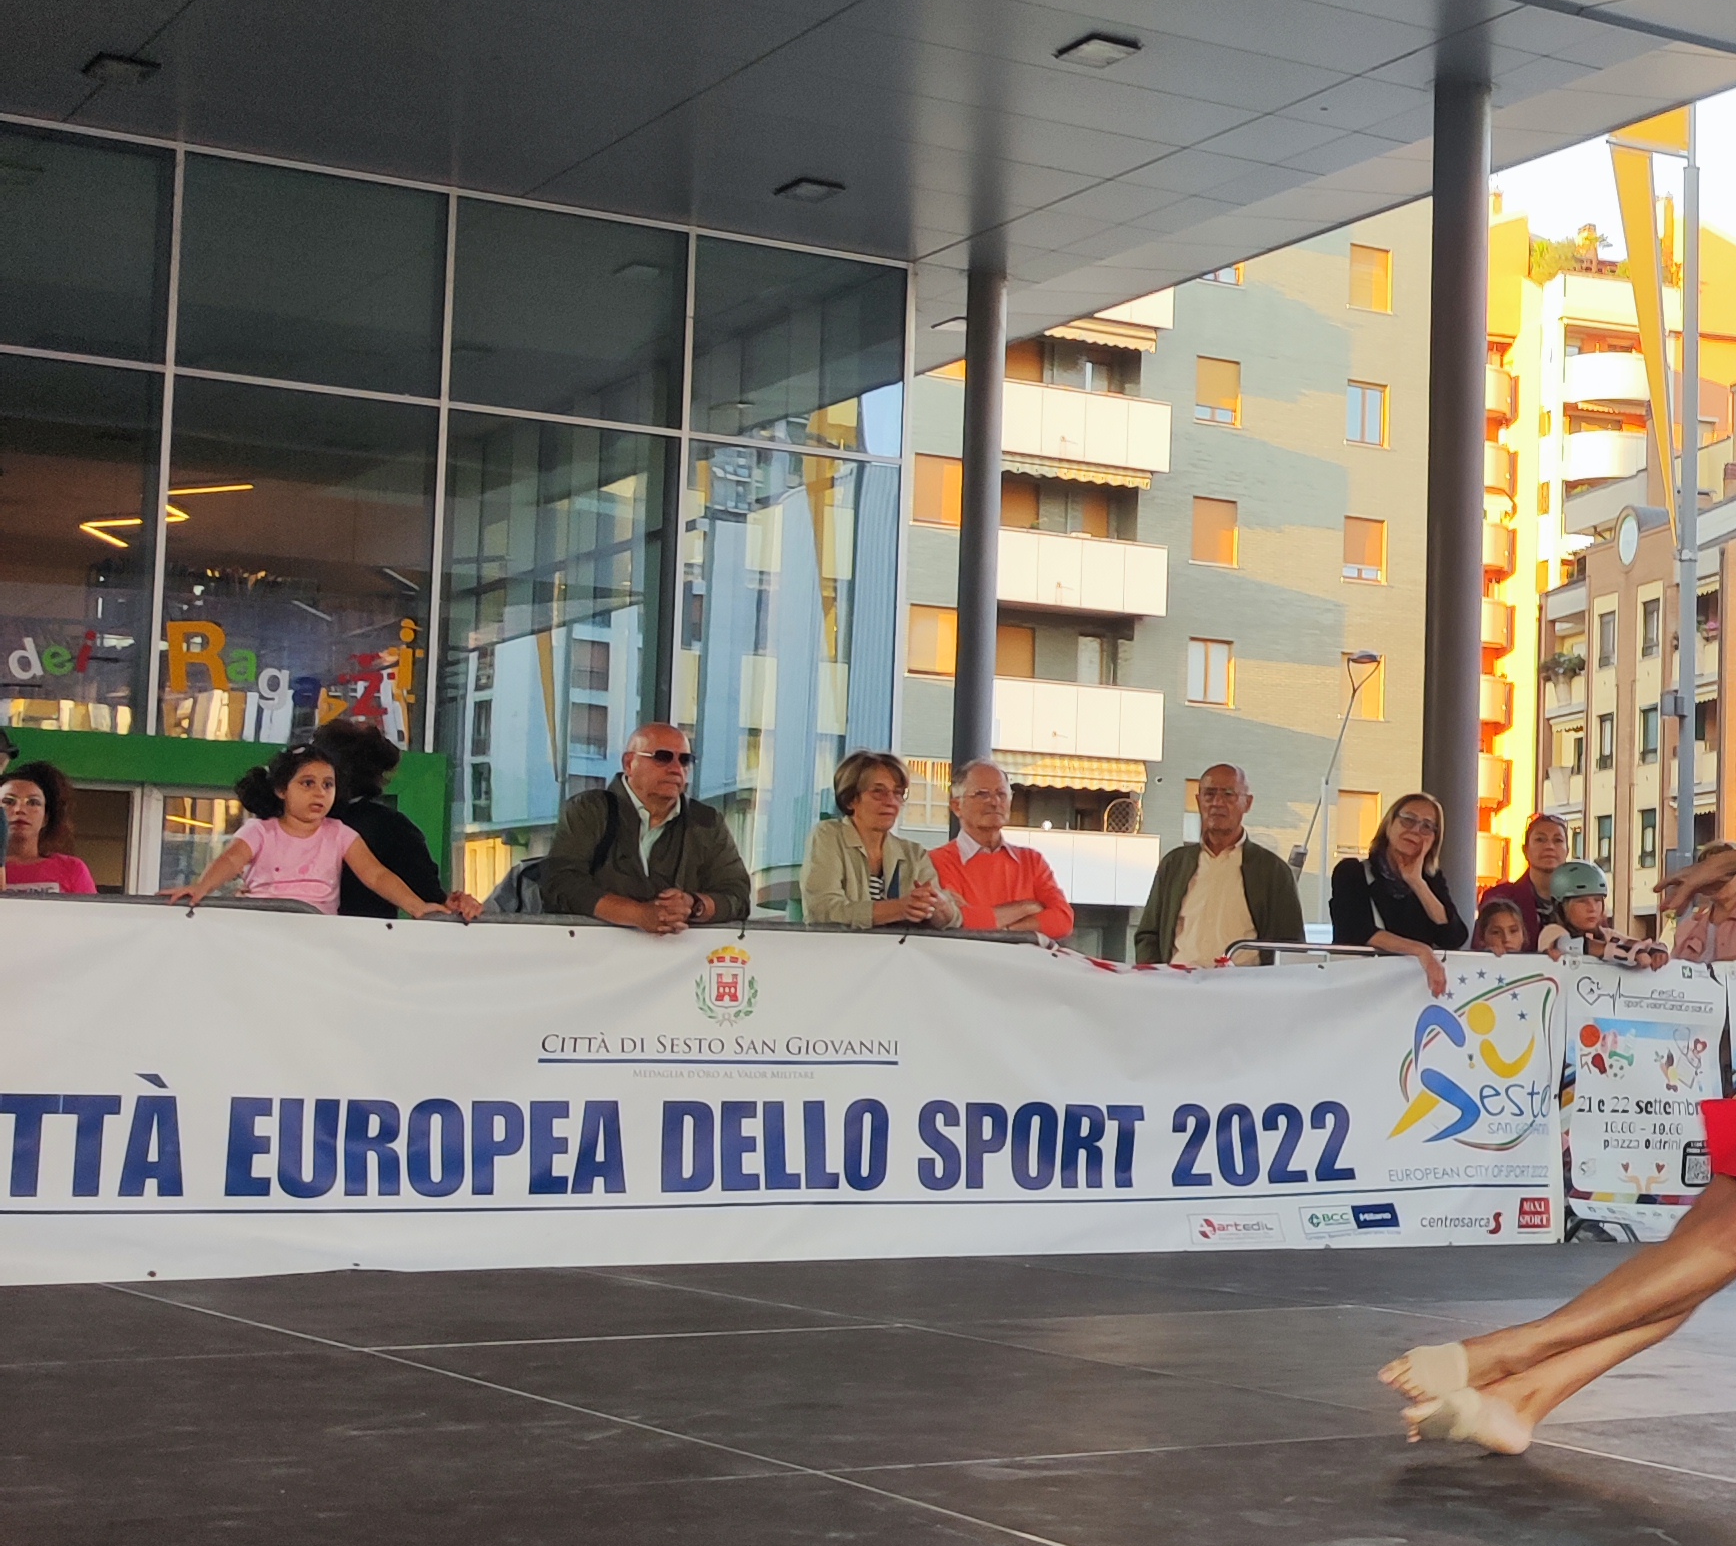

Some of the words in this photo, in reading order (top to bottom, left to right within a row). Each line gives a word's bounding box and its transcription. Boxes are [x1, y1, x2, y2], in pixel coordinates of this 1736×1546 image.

[8, 630, 98, 681] dei
[1576, 1095, 1593, 1113] 21
[1597, 1098, 1605, 1113] e
[1610, 1096, 1630, 1113] 22
[1634, 1097, 1701, 1116] settembr
[0, 1073, 184, 1197] TTÀ
[224, 1096, 627, 1198] EUROPEA
[661, 1098, 889, 1193] DELLO
[917, 1099, 1146, 1191] SPORT
[1171, 1100, 1357, 1187] 2022
[1603, 1138, 1640, 1150] piazza
[1388, 1166, 1461, 1182] EUROPEAN
[1464, 1164, 1490, 1179] CITY
[1322, 1212, 1349, 1222] BCC
